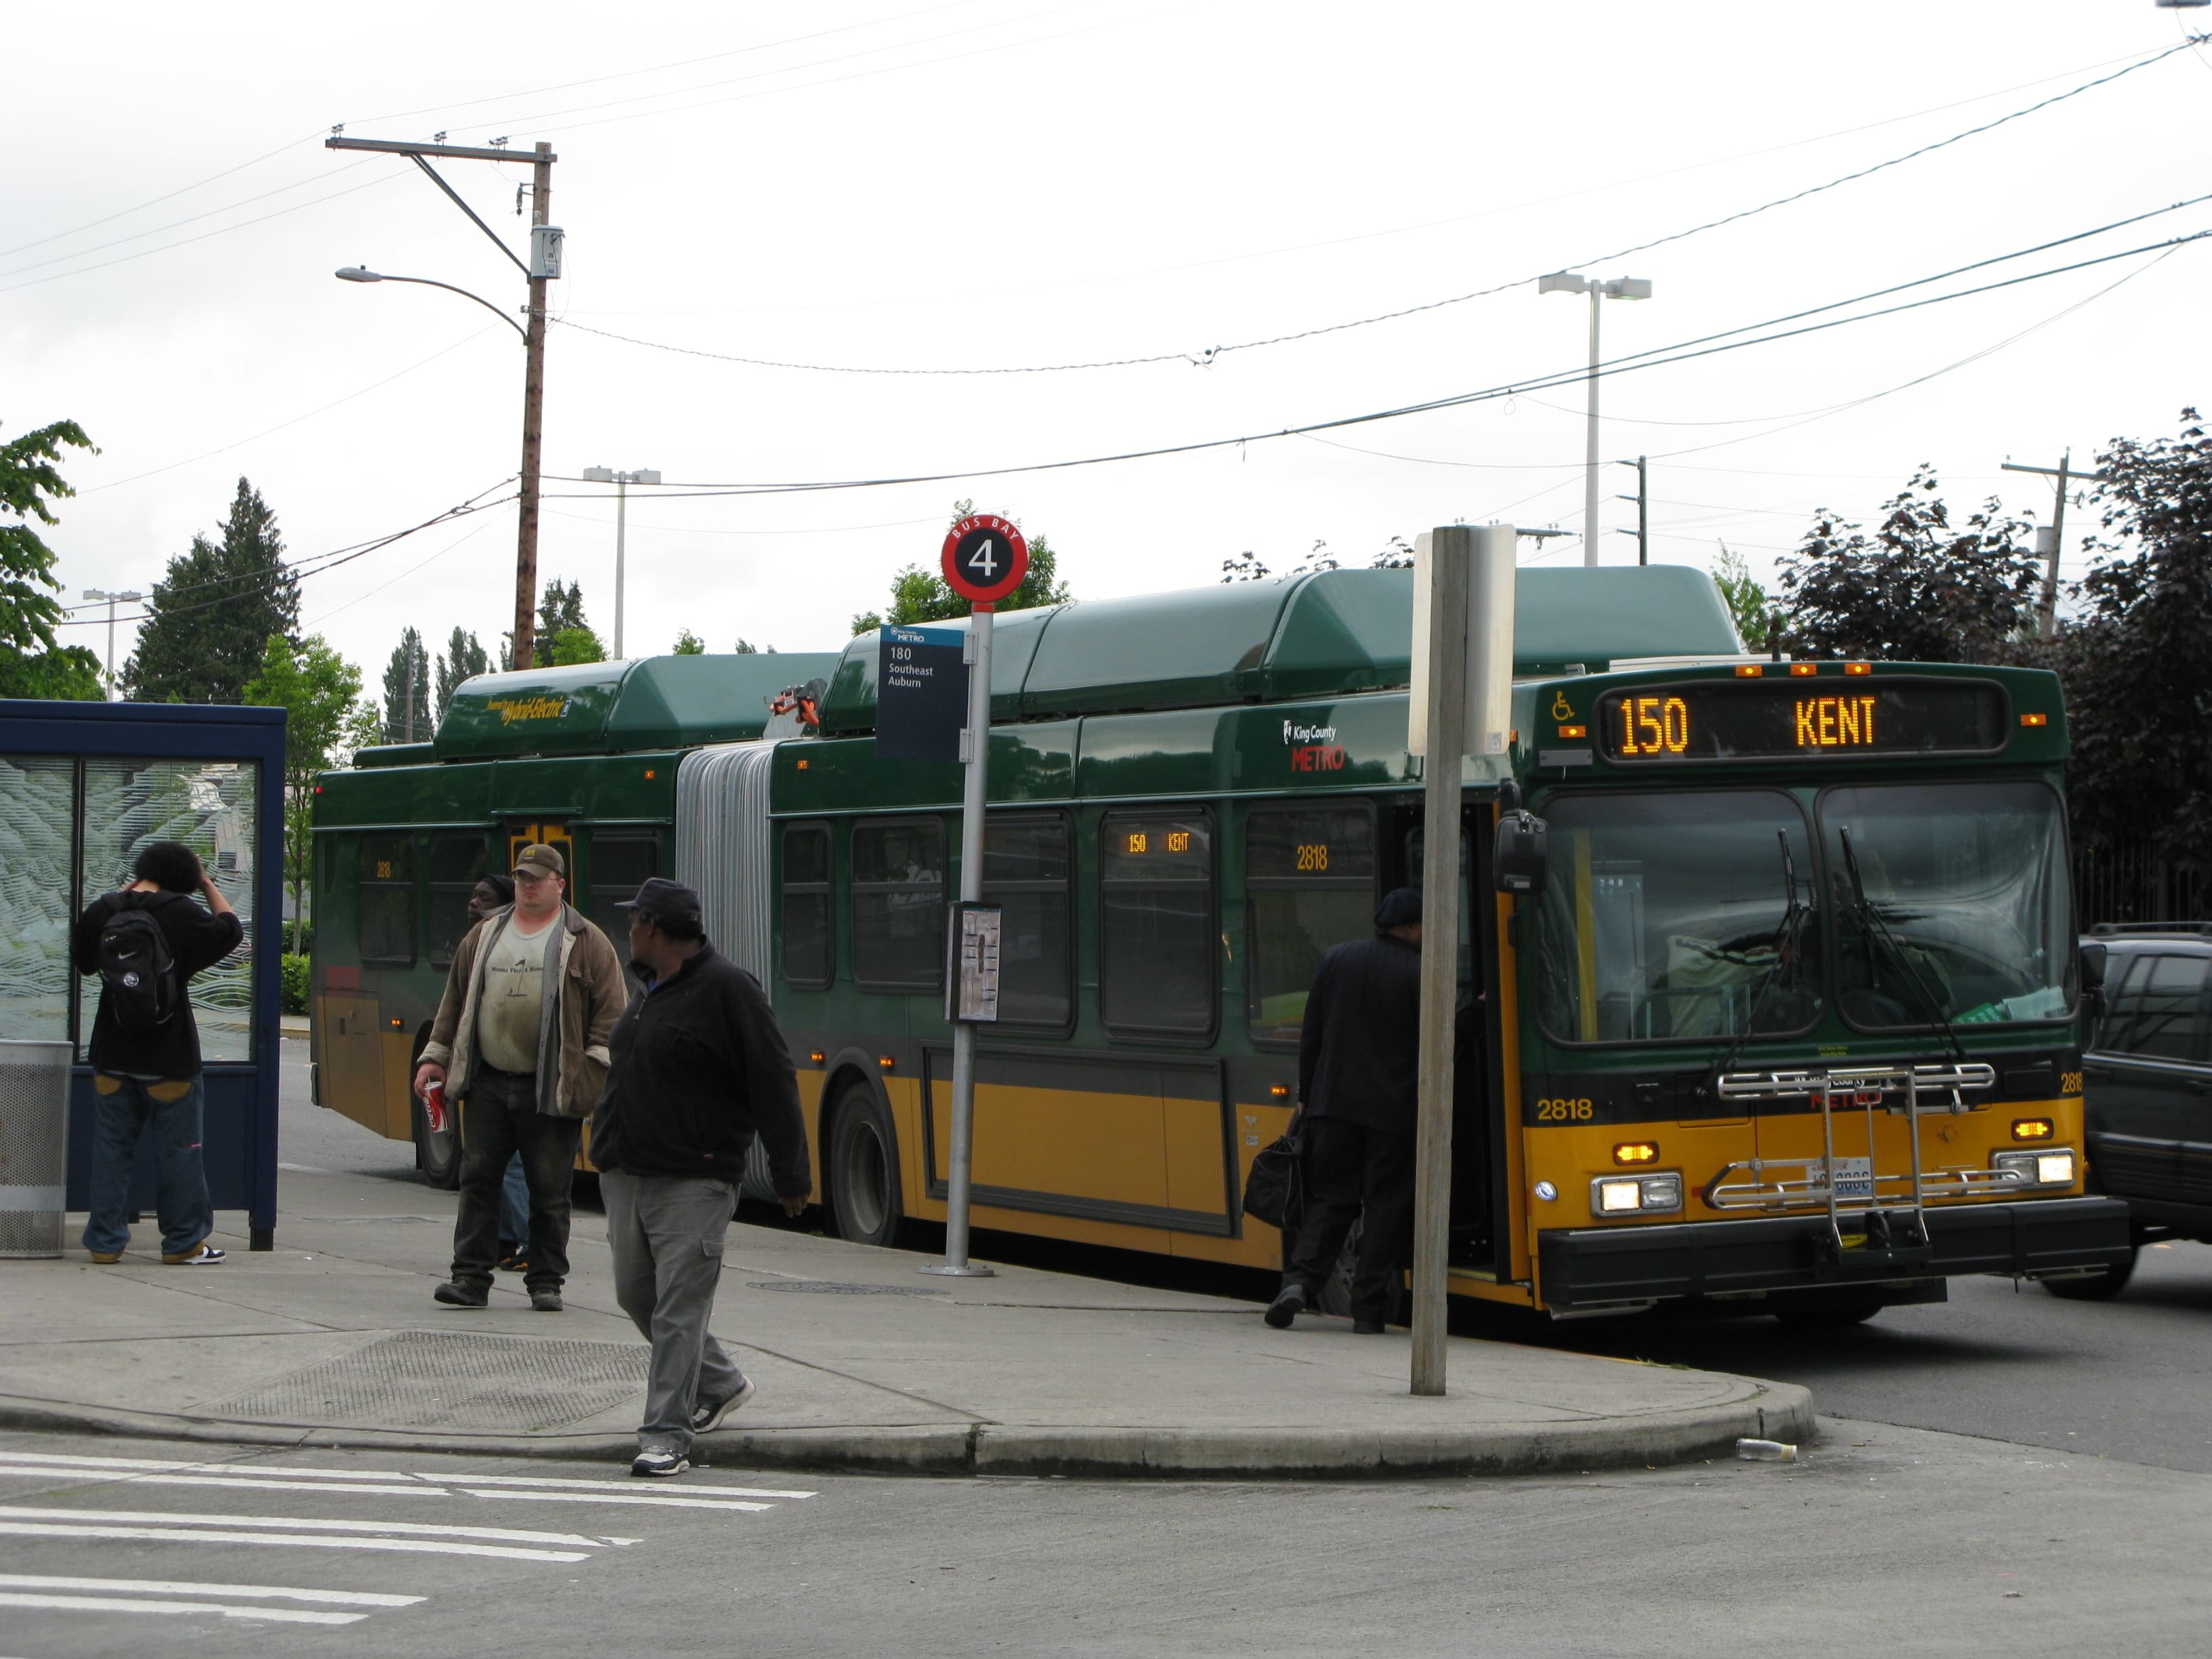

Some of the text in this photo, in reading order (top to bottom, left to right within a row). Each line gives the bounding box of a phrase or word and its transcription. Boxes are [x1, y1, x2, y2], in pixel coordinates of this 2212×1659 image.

[952, 517, 1019, 539] BUS BAY
[965, 539, 997, 576] 4
[898, 634, 924, 643] METRO
[890, 647, 912, 661] 180
[889, 663, 933, 676] Southeast
[888, 676, 921, 689] Auburn
[1294, 724, 1336, 743] King County
[1622, 696, 1875, 753] 150 KENT
[1292, 745, 1345, 772] METRO
[1129, 832, 1189, 852] 150 KENT
[1296, 845, 1328, 871] 2818
[2061, 1071, 2083, 1093] 2818
[1538, 1099, 1593, 1120] 2818
